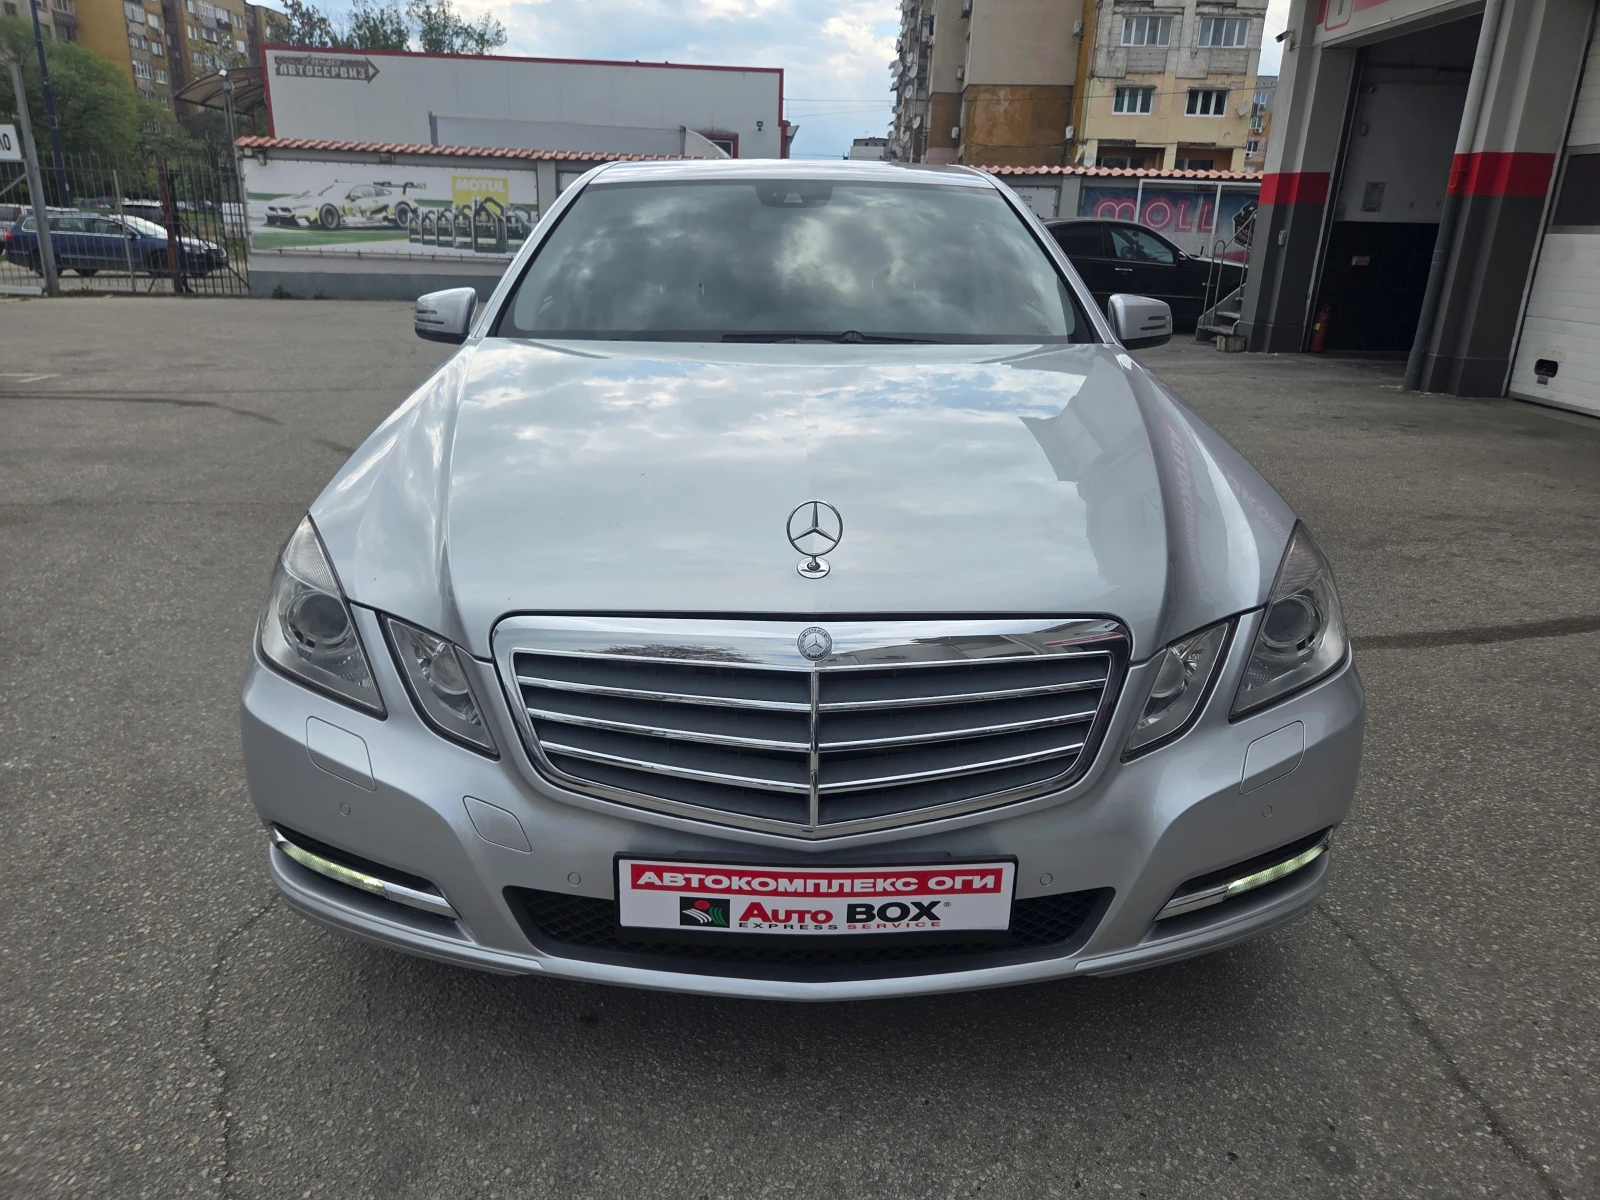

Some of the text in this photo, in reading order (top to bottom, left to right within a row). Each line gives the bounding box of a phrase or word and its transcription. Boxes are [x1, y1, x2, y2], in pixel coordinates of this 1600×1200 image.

[279, 64, 366, 80] АВТОСЕРВИЗ
[455, 178, 505, 193] MOTUL
[1093, 197, 1218, 232] MOLL
[636, 871, 995, 893] АВТОКОМПЛЕКС ОГИ
[739, 921, 940, 930] EXPRESS SERVICE
